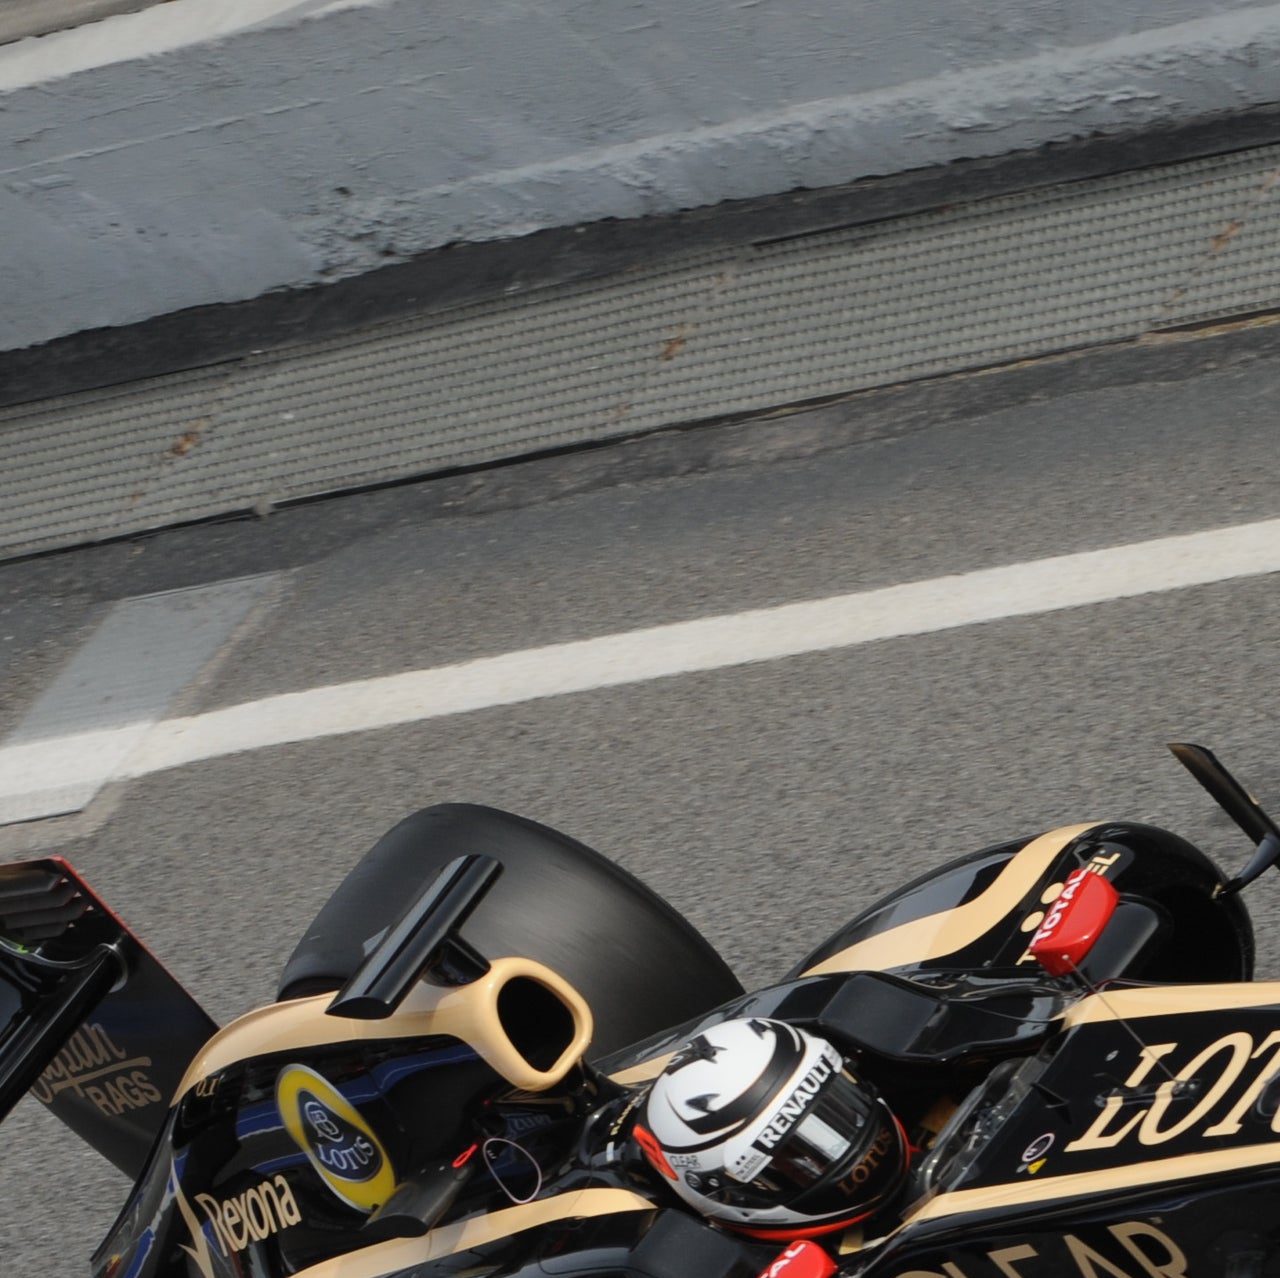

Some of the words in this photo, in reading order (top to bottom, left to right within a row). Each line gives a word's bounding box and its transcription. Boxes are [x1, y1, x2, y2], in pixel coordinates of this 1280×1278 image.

[1029, 868, 1089, 947] TOTAL
[85, 1071, 162, 1116] RAGS
[756, 1055, 834, 1149] RENAULT
[315, 1136, 375, 1170] LOTUS
[837, 1128, 893, 1195] LOTUS
[193, 1174, 301, 1257] Rexona
